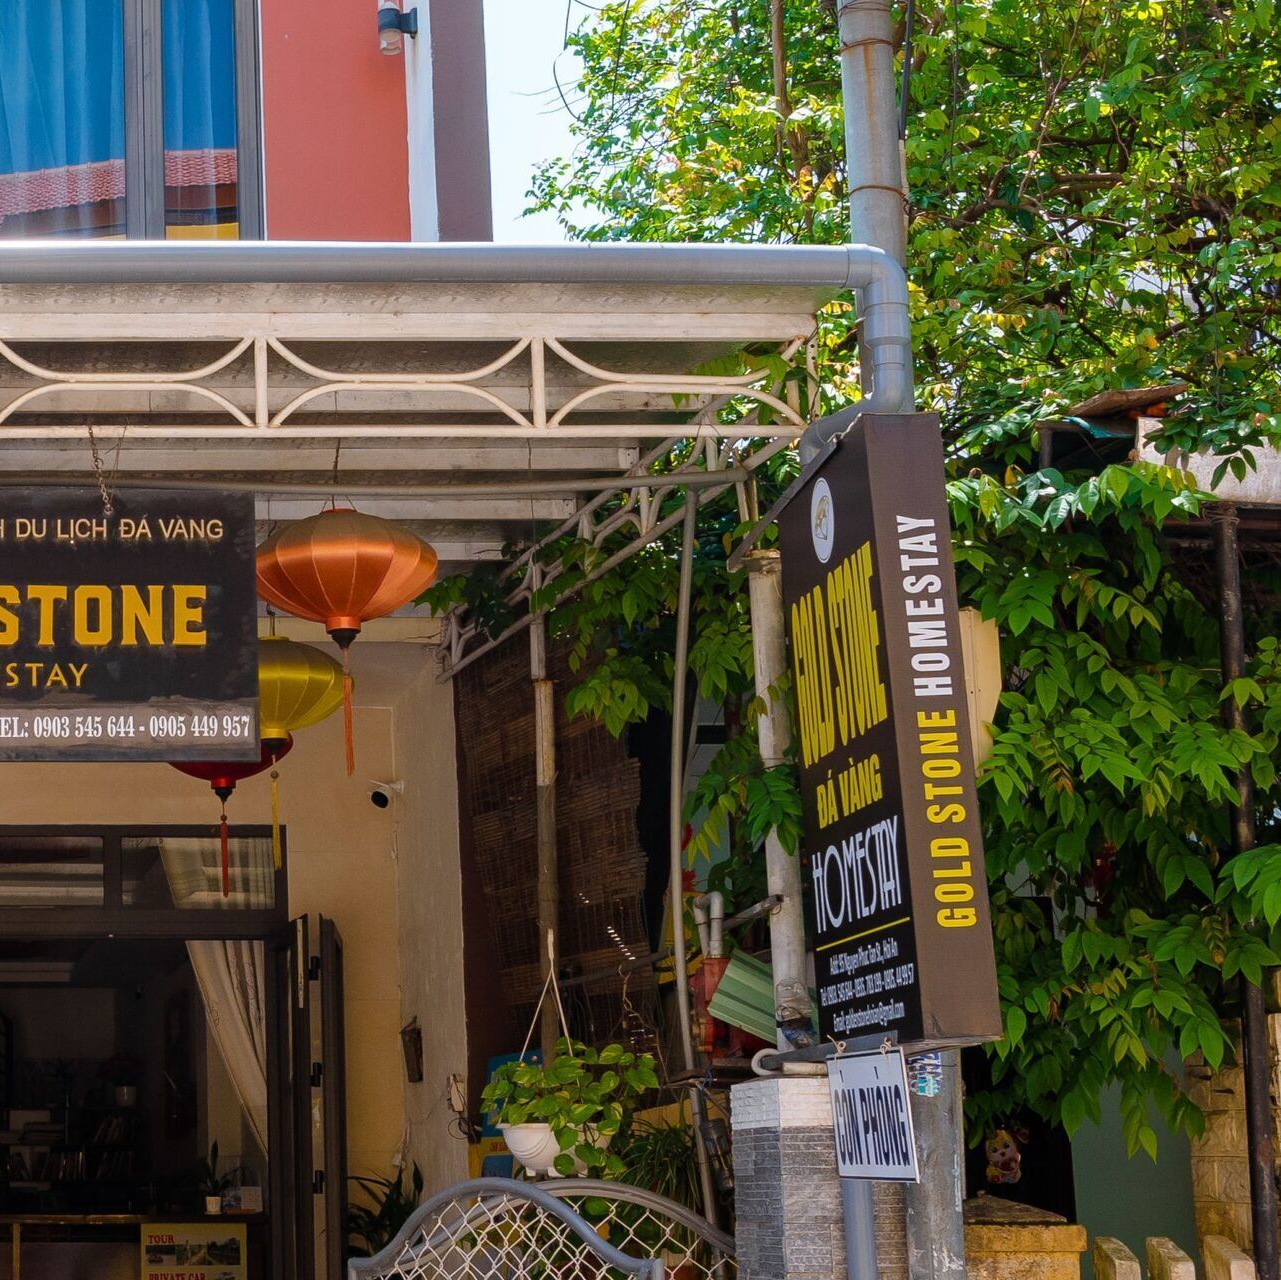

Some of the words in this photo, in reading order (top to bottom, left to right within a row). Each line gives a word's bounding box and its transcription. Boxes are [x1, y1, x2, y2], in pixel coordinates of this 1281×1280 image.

[16, 519, 47, 539] DU
[57, 519, 108, 545] LỊCH
[119, 515, 152, 539] ĐÁ
[158, 515, 224, 540] VÀNG
[896, 514, 954, 697] HOMESTAY
[791, 584, 836, 770] GOLD
[826, 540, 889, 746] STONE
[34, 716, 70, 738] 0903
[75, 716, 102, 738] 545
[107, 716, 135, 737] 644
[149, 716, 186, 738] 0905
[190, 716, 218, 737] 449
[223, 716, 250, 737] 957
[916, 708, 968, 824] STONE
[817, 769, 839, 830] ĐÁ
[838, 753, 884, 817] VÀNG
[812, 815, 903, 934] HOMESTAY
[930, 837, 978, 929] GOLD
[834, 1069, 863, 1166] CÒN
[858, 1066, 911, 1167] PHÒNG
[148, 1234, 174, 1244] TOUR
